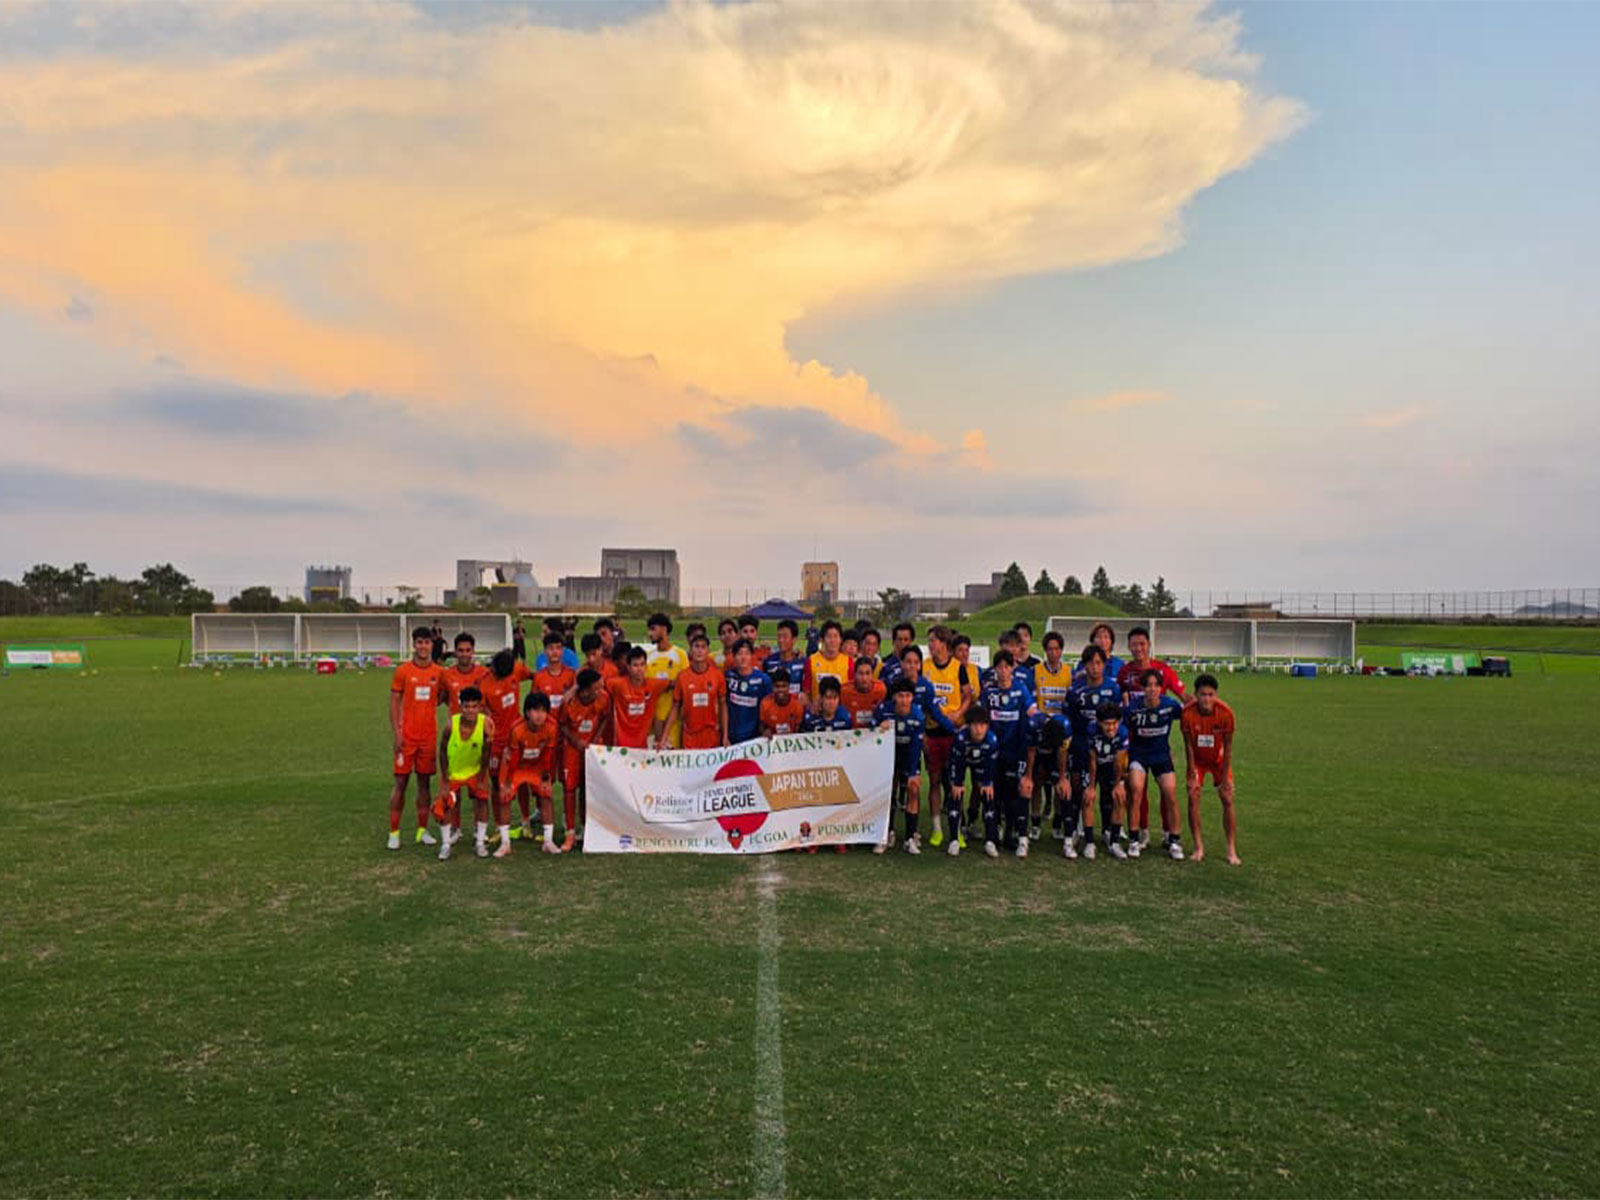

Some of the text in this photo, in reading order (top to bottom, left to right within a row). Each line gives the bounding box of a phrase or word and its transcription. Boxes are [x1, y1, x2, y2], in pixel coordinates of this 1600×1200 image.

[659, 736, 823, 769] WELCOME TO JAPAN!
[770, 769, 840, 793] JAPAN TOUR
[703, 793, 755, 813] LEAGUE
[750, 831, 788, 845] FC GOA
[818, 822, 875, 836] PUNJAB FC
